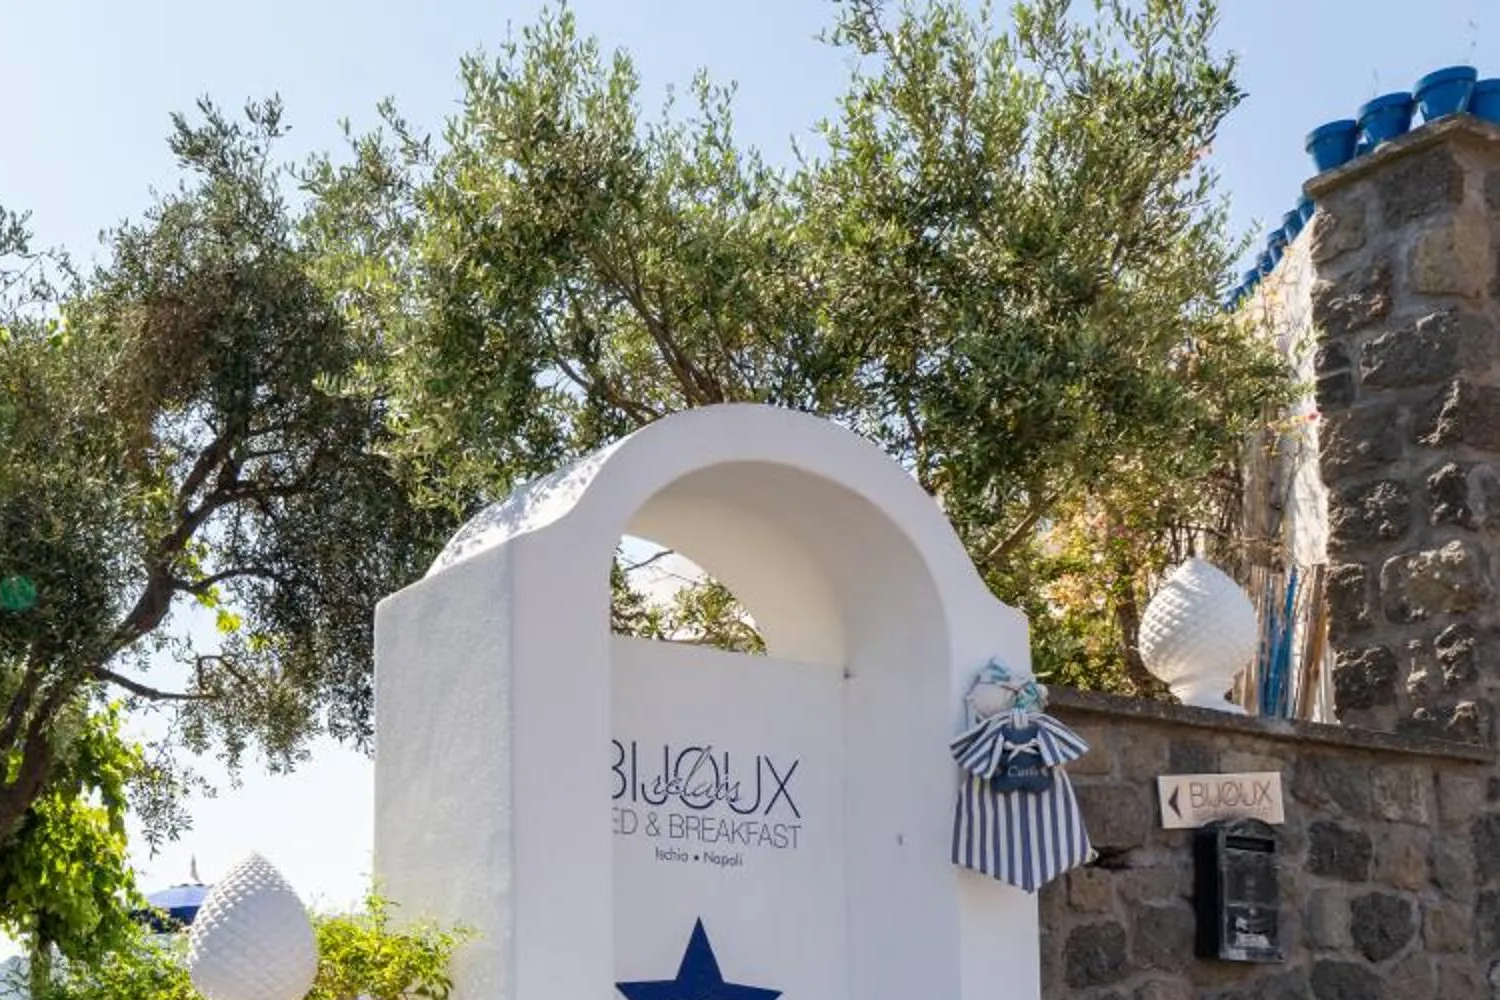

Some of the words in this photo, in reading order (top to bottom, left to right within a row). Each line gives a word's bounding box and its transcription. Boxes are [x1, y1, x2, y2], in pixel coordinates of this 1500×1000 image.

[1189, 780, 1274, 809] BIJOUX
[611, 806, 639, 836] ED
[645, 811, 662, 837] &
[668, 812, 802, 850] BREAKFAST
[703, 850, 743, 868] Napoli
